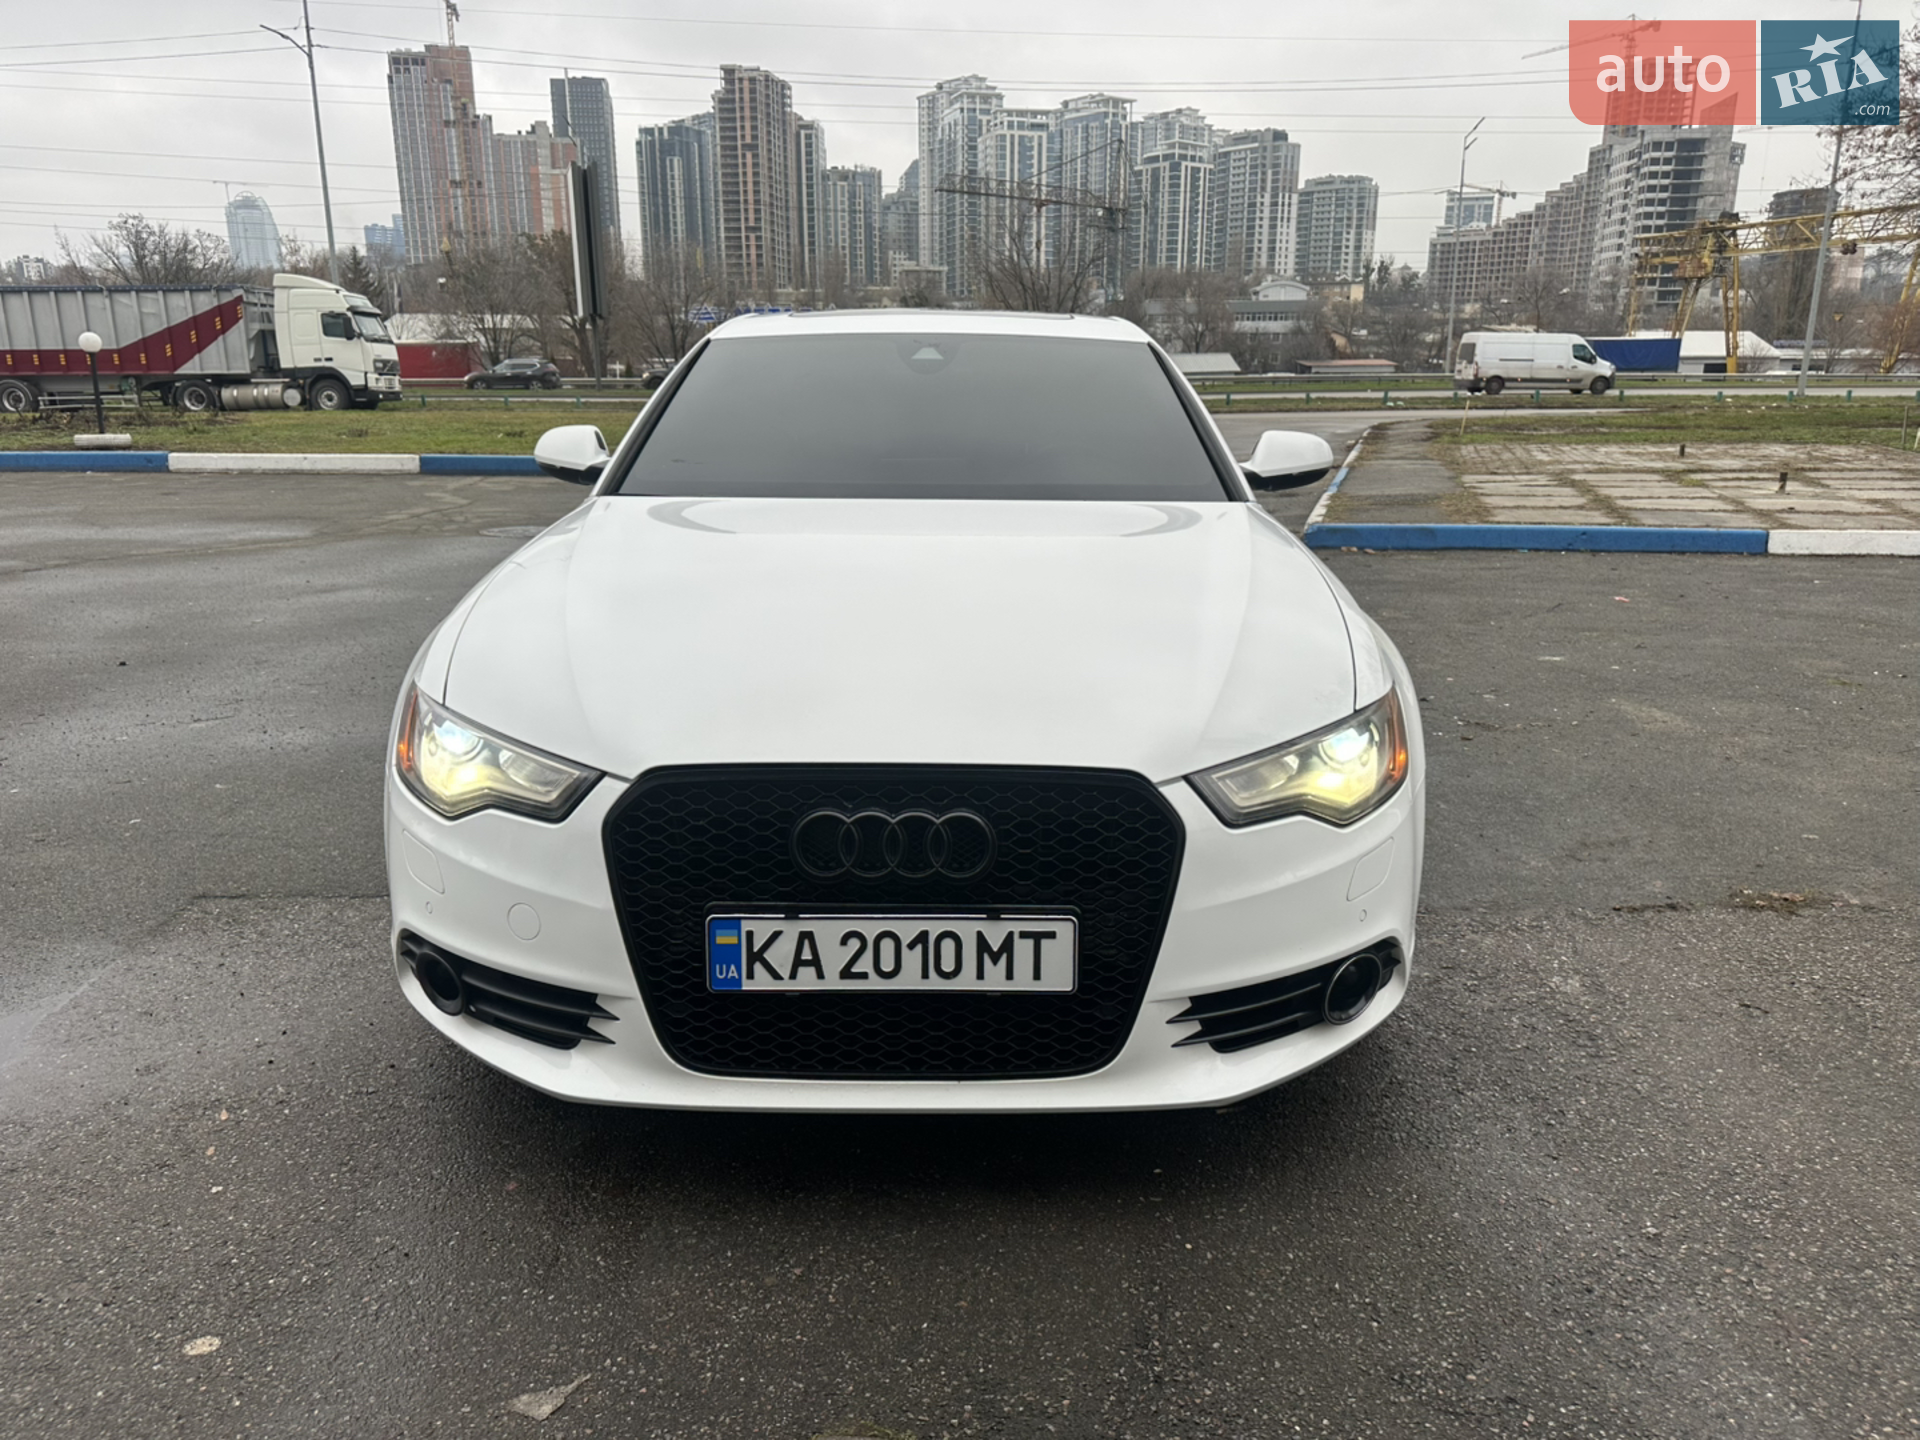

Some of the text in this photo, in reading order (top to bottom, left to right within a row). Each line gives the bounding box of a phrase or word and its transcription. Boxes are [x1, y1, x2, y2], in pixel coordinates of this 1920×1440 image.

[716, 964, 740, 980] UA
[745, 929, 1057, 981] KA 2010 MT
